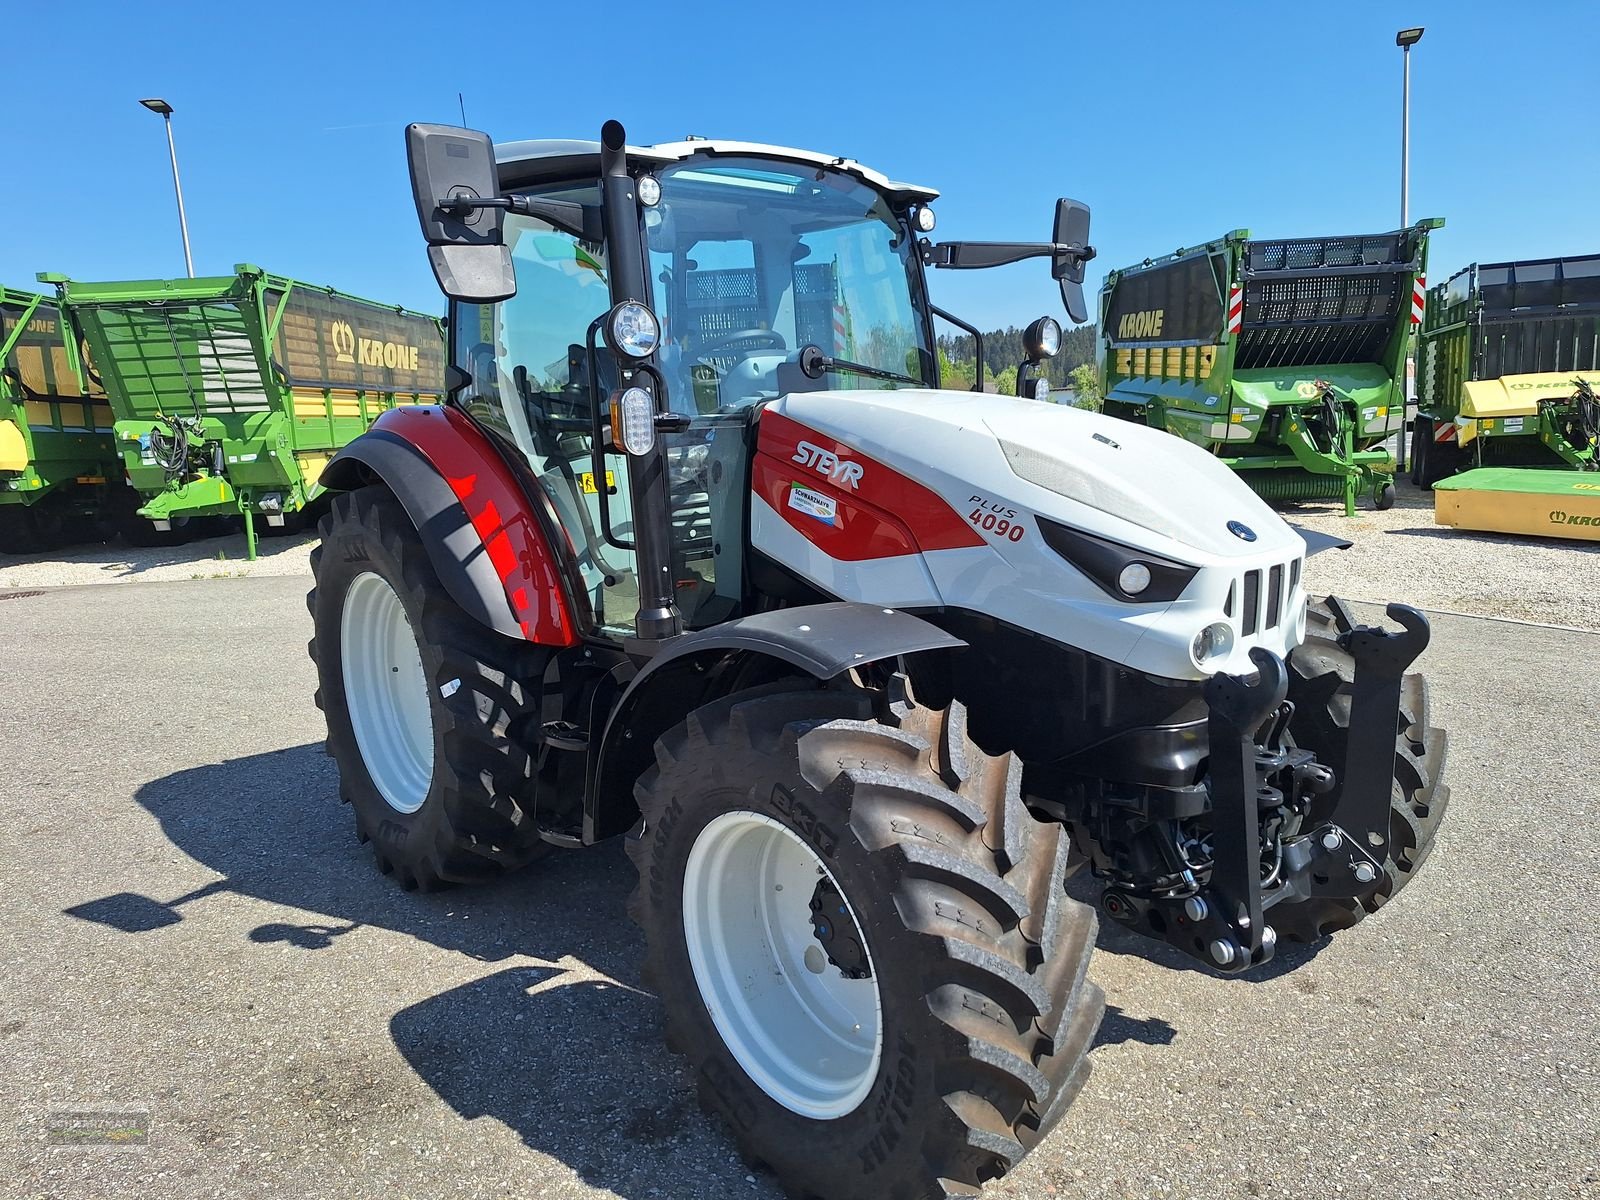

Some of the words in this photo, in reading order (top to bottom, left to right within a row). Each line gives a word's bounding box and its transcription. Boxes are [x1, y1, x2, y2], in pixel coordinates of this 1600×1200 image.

[5, 317, 55, 334] KONE
[1118, 309, 1164, 339] KRONE
[358, 337, 418, 371] KRONE
[791, 440, 864, 490] STEYR
[968, 495, 1018, 519] PLUS
[968, 508, 1025, 543] 4090
